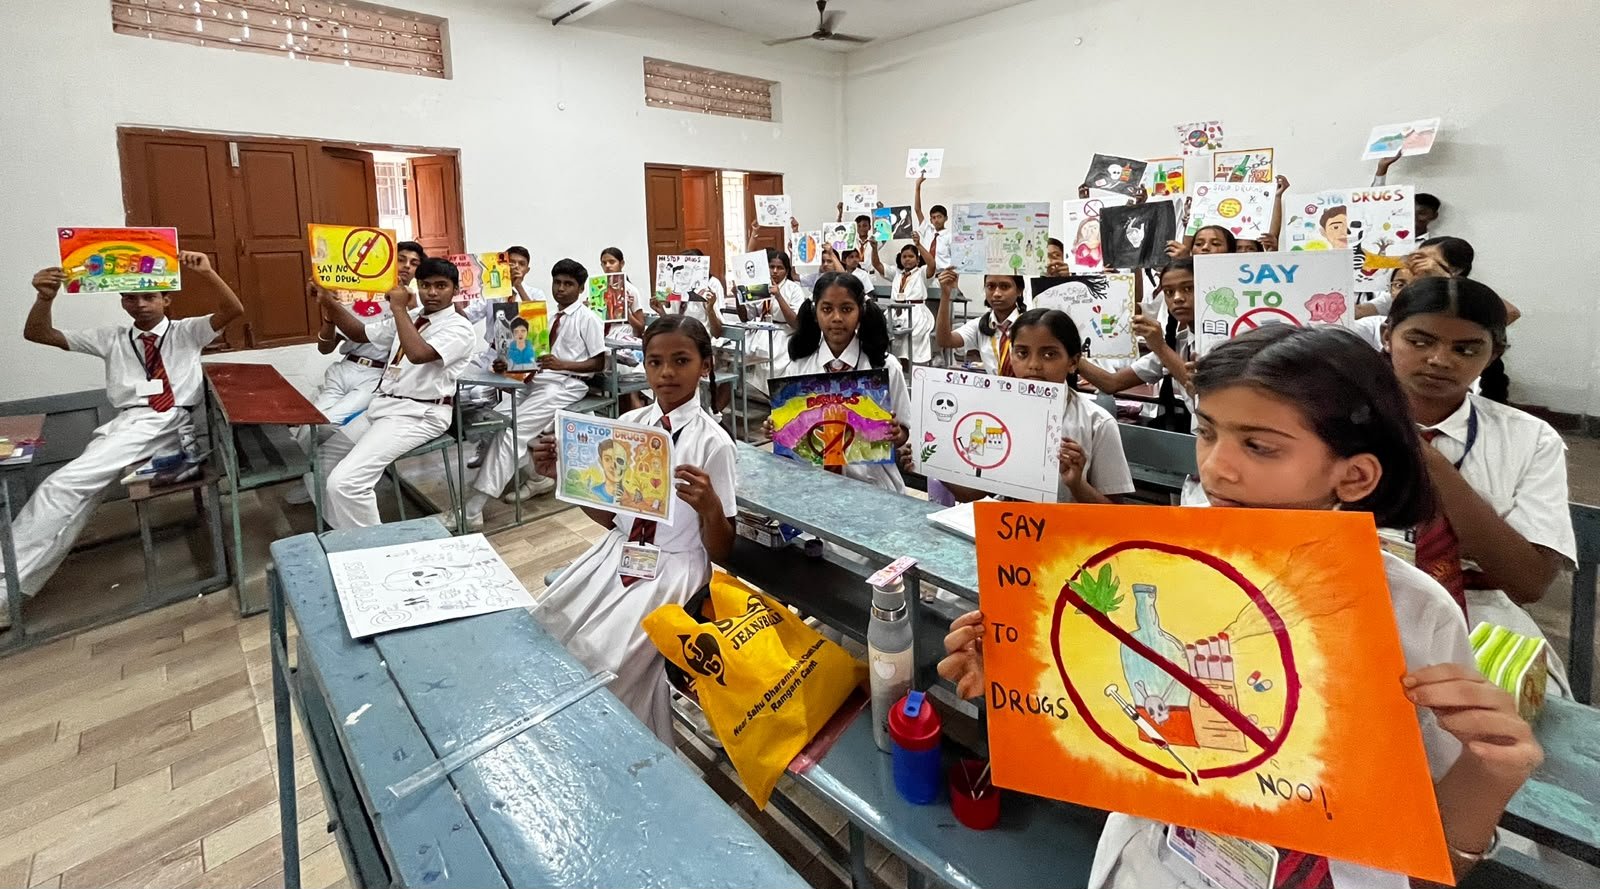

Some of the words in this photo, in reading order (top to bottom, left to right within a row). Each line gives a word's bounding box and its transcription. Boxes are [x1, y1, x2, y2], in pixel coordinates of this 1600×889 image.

[1351, 189, 1404, 203] DRUGS
[317, 264, 333, 274] SAY
[336, 264, 349, 273] NO
[335, 275, 360, 284] DRUGS
[1237, 263, 1300, 285] SAY
[1242, 290, 1283, 308] TO
[945, 371, 968, 384] SAY
[973, 375, 991, 388] NO
[997, 379, 1012, 391] TO
[1018, 381, 1059, 399] DRUGS
[587, 425, 612, 438] STOP
[614, 430, 647, 443] DRUGS
[997, 511, 1047, 541] SAY
[991, 621, 1018, 644] TO
[769, 677, 802, 713] Ramgarh
[991, 681, 1070, 720] DRUGS
[733, 718, 749, 737] Near
[746, 700, 766, 721] Sahu
